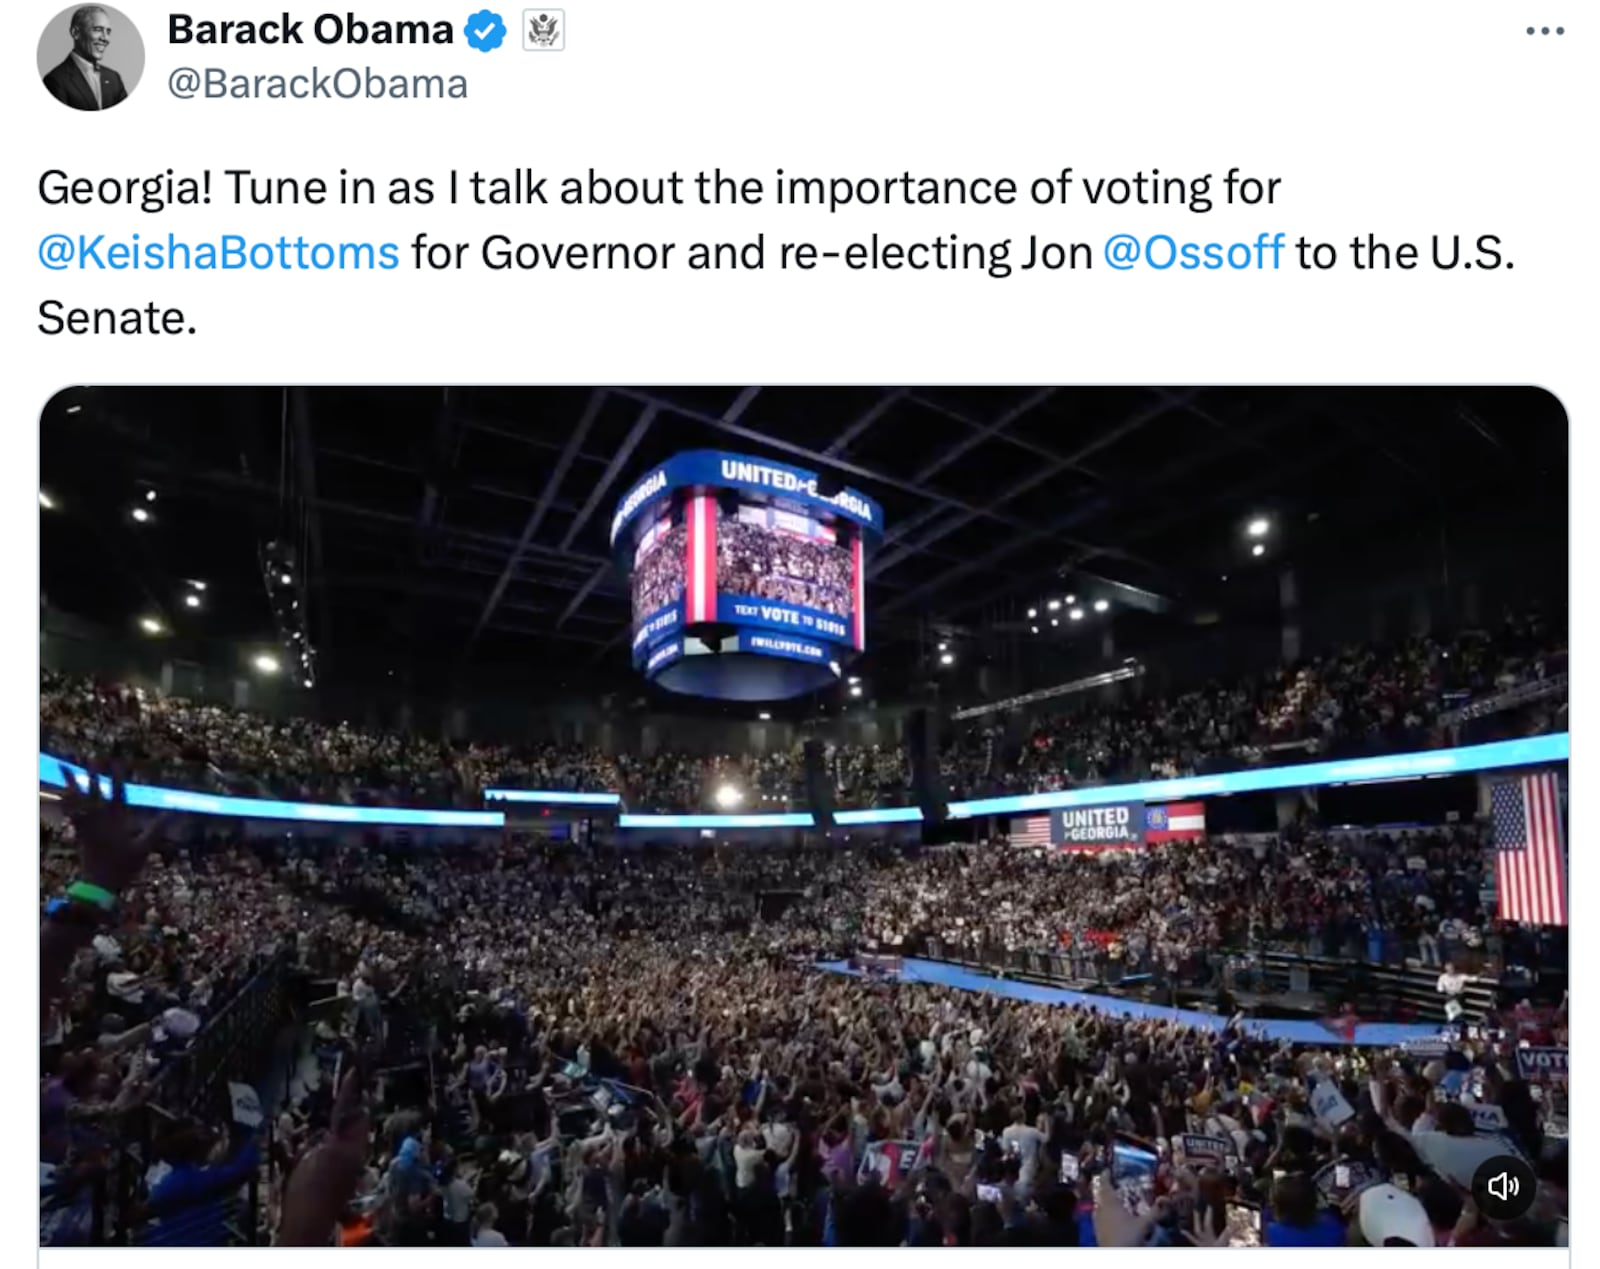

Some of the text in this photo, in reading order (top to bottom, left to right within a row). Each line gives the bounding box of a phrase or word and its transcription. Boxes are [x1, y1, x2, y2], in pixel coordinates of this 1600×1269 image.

[721, 459, 872, 521] UNITED GRGIA
[735, 604, 759, 617] TEXT
[760, 605, 800, 625] VOTE
[802, 614, 814, 626] TO
[1062, 806, 1130, 828] UNITED
[1071, 825, 1129, 841] GEORGIA
[1521, 1052, 1568, 1068] VOT
